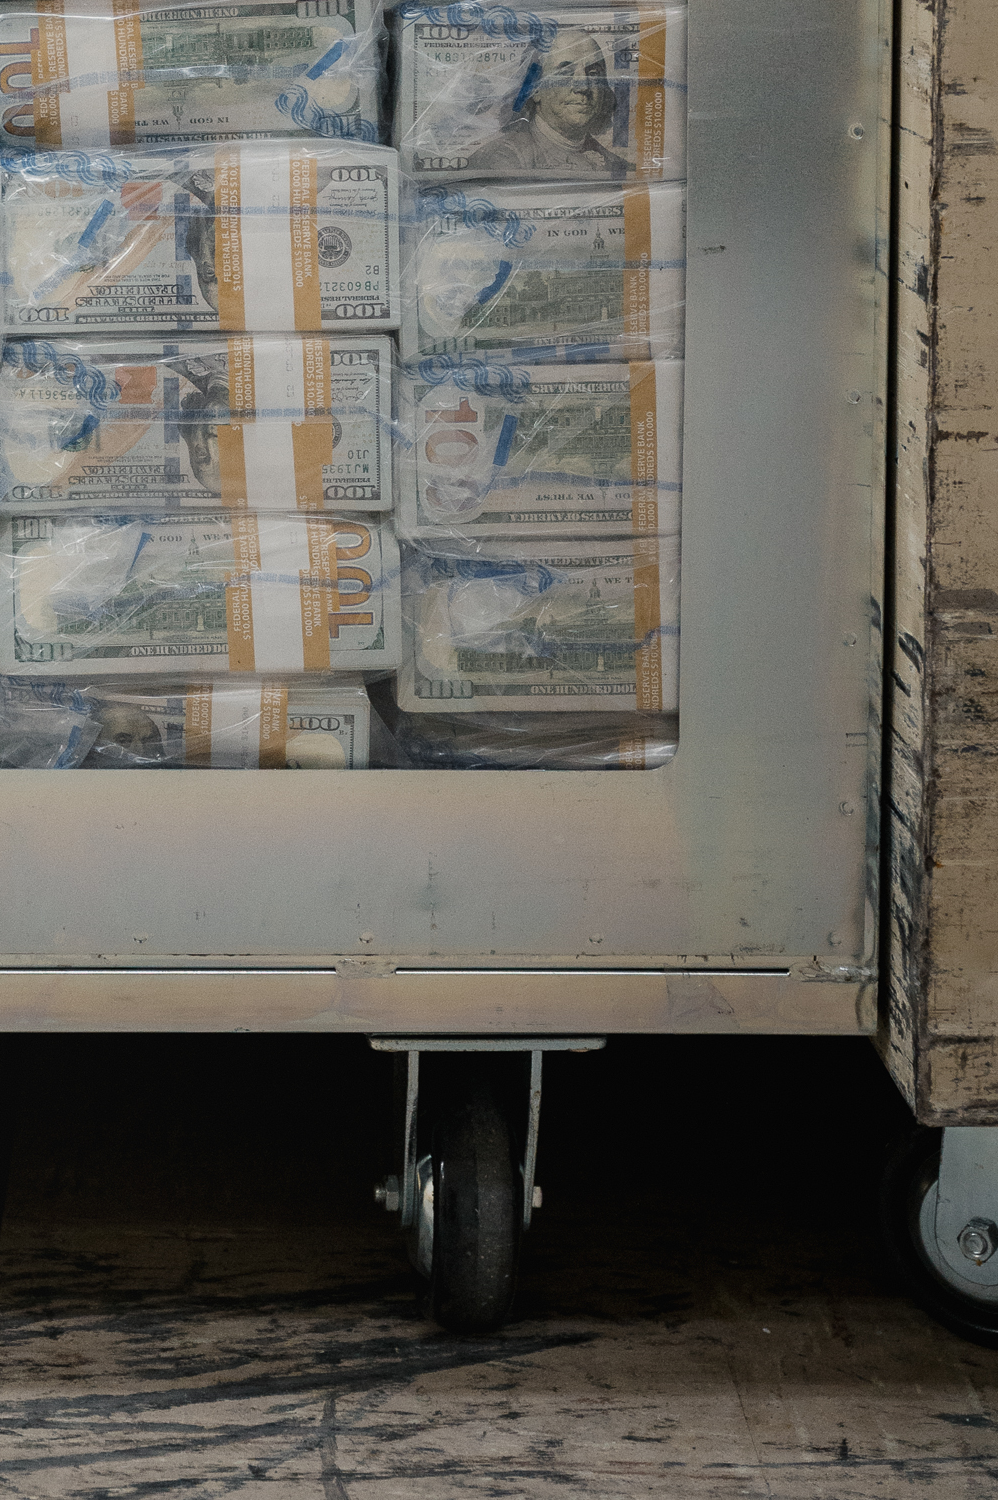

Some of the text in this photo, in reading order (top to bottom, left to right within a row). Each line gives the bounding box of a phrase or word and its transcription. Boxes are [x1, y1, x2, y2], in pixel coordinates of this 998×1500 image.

[418, 24, 470, 40] 100
[423, 41, 463, 49] FEDERAL
[462, 41, 503, 49] RESERVE
[118, 92, 129, 116] BANK
[643, 101, 653, 128] BANK
[421, 156, 470, 170] 100
[330, 168, 380, 182] 100
[546, 229, 588, 237] IN GOD
[303, 249, 313, 278] BANK
[365, 265, 380, 275] B2
[364, 281, 380, 291] PB
[630, 275, 639, 303] BANK
[334, 303, 385, 319] 100
[645, 411, 655, 449] $10,000
[637, 421, 646, 455] BANK
[347, 450, 370, 460] J10
[325, 484, 376, 499] 100
[535, 493, 574, 502] TRUST
[603, 576, 622, 585] WE
[232, 590, 241, 632] FEDERAL
[303, 599, 313, 637] $10,000
[311, 601, 322, 628] BANK
[131, 645, 216, 656] ONE HUNDRED
[530, 685, 554, 695] ONE
[271, 709, 280, 732] BANK
[289, 716, 341, 731] 100
